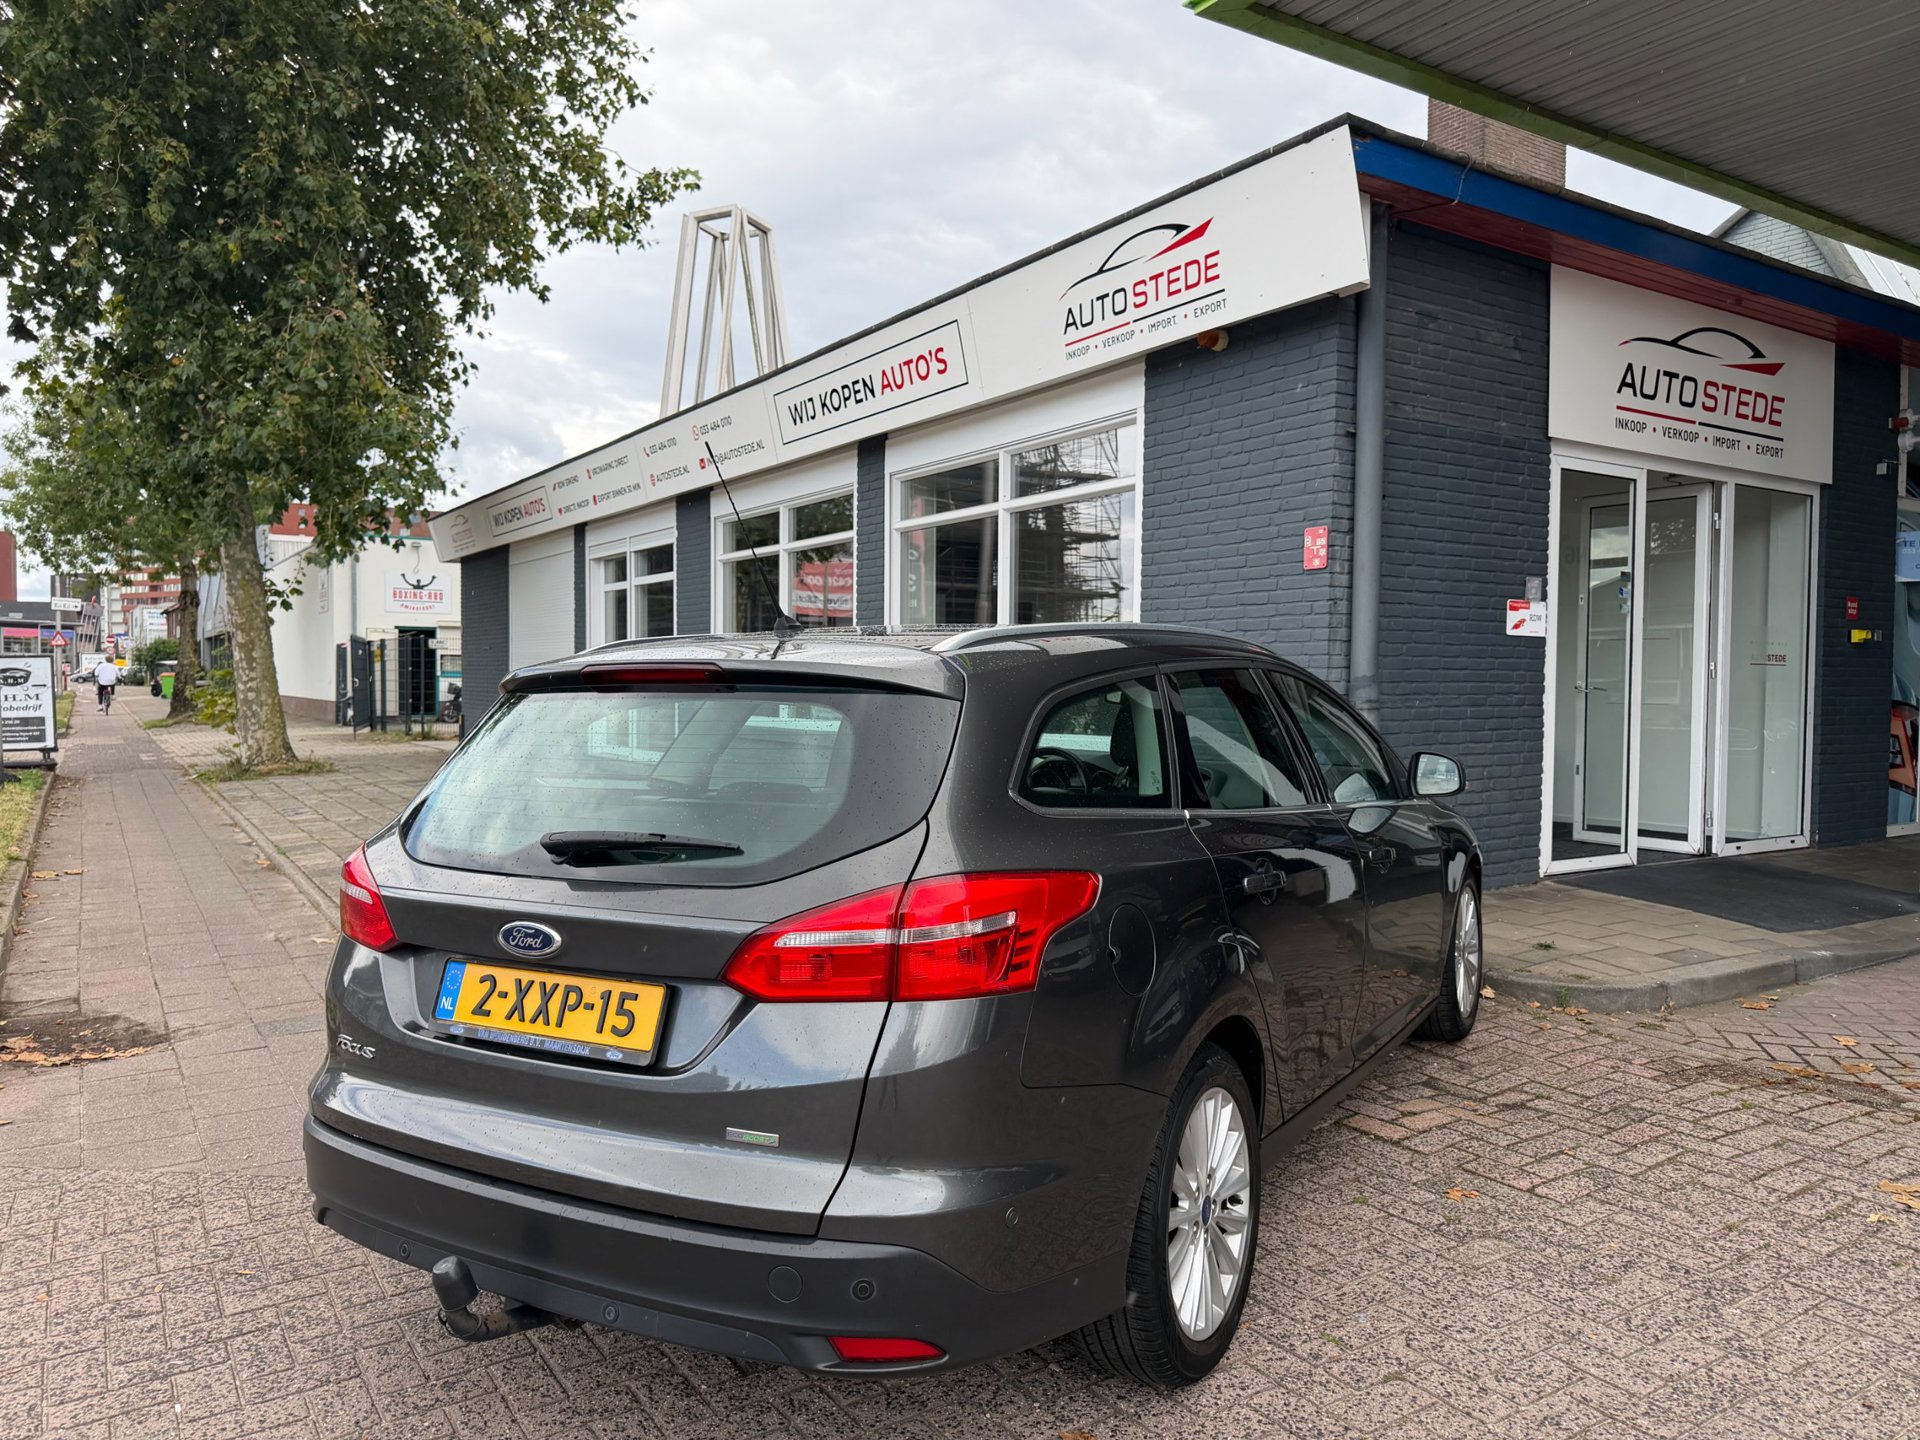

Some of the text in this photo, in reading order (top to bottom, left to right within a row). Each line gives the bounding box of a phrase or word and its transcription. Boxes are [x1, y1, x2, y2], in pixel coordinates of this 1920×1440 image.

[1065, 298, 1228, 361] INKOOP VERKOOP IMPORT EXPORT
[787, 346, 949, 427] WIJ KOPEN AUTO'S
[706, 438, 766, 467] INO@AUTOSTEDE.NL
[1615, 416, 1784, 460] INKOOP VERKOOP IMPORT EXPORT
[2, 703, 42, 713] obedrijf
[509, 926, 543, 949] Ford
[439, 995, 454, 1012] NL
[470, 973, 639, 1037] 2-XXP-15
